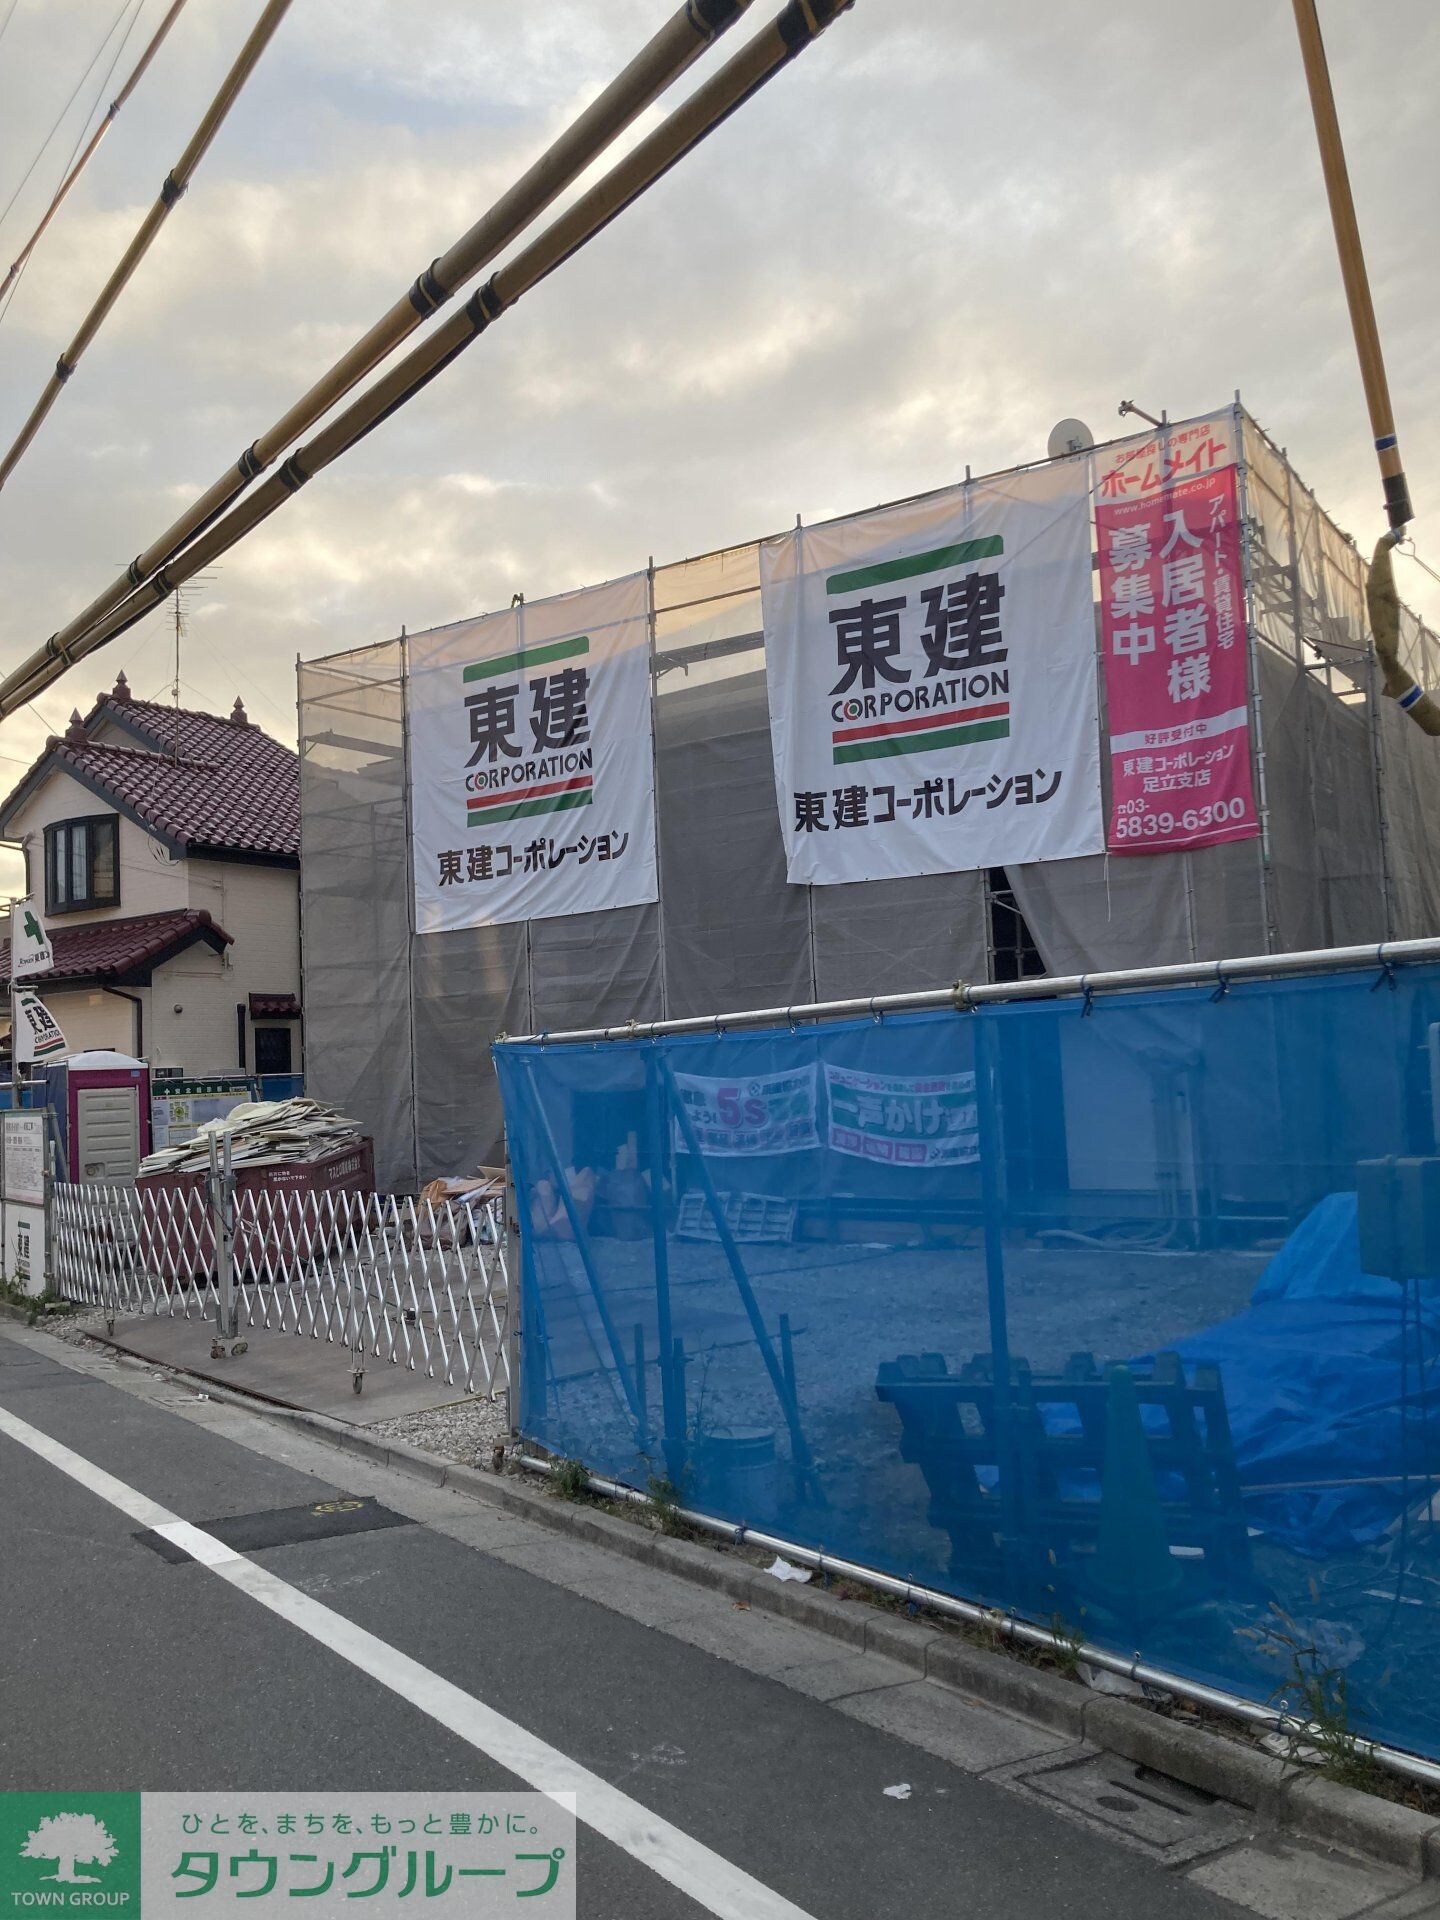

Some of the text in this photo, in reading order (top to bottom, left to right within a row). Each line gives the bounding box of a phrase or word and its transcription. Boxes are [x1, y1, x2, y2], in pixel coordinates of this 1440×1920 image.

[1101, 438, 1227, 498] ホームメイト
[1114, 423, 1211, 464] お部屋探しの専門店
[1113, 477, 1216, 516] www.homemate.co.jp
[1108, 521, 1156, 666] 募集中
[1209, 493, 1238, 650] アパート・賃貸住宅
[1158, 508, 1212, 704] 入居者様
[828, 572, 1009, 697] 東建
[463, 667, 591, 769] 東建
[831, 670, 1010, 723] CORPORATION
[1122, 744, 1235, 777] 東建コーポレーション
[1144, 722, 1208, 745] 好評受付中
[465, 747, 593, 792] CORPORATION
[1142, 768, 1212, 794] 足立支店
[793, 768, 1063, 833] 東建コーポレーション
[1116, 797, 1246, 839] 5839-6300
[437, 830, 630, 887] 東建コーポレーション
